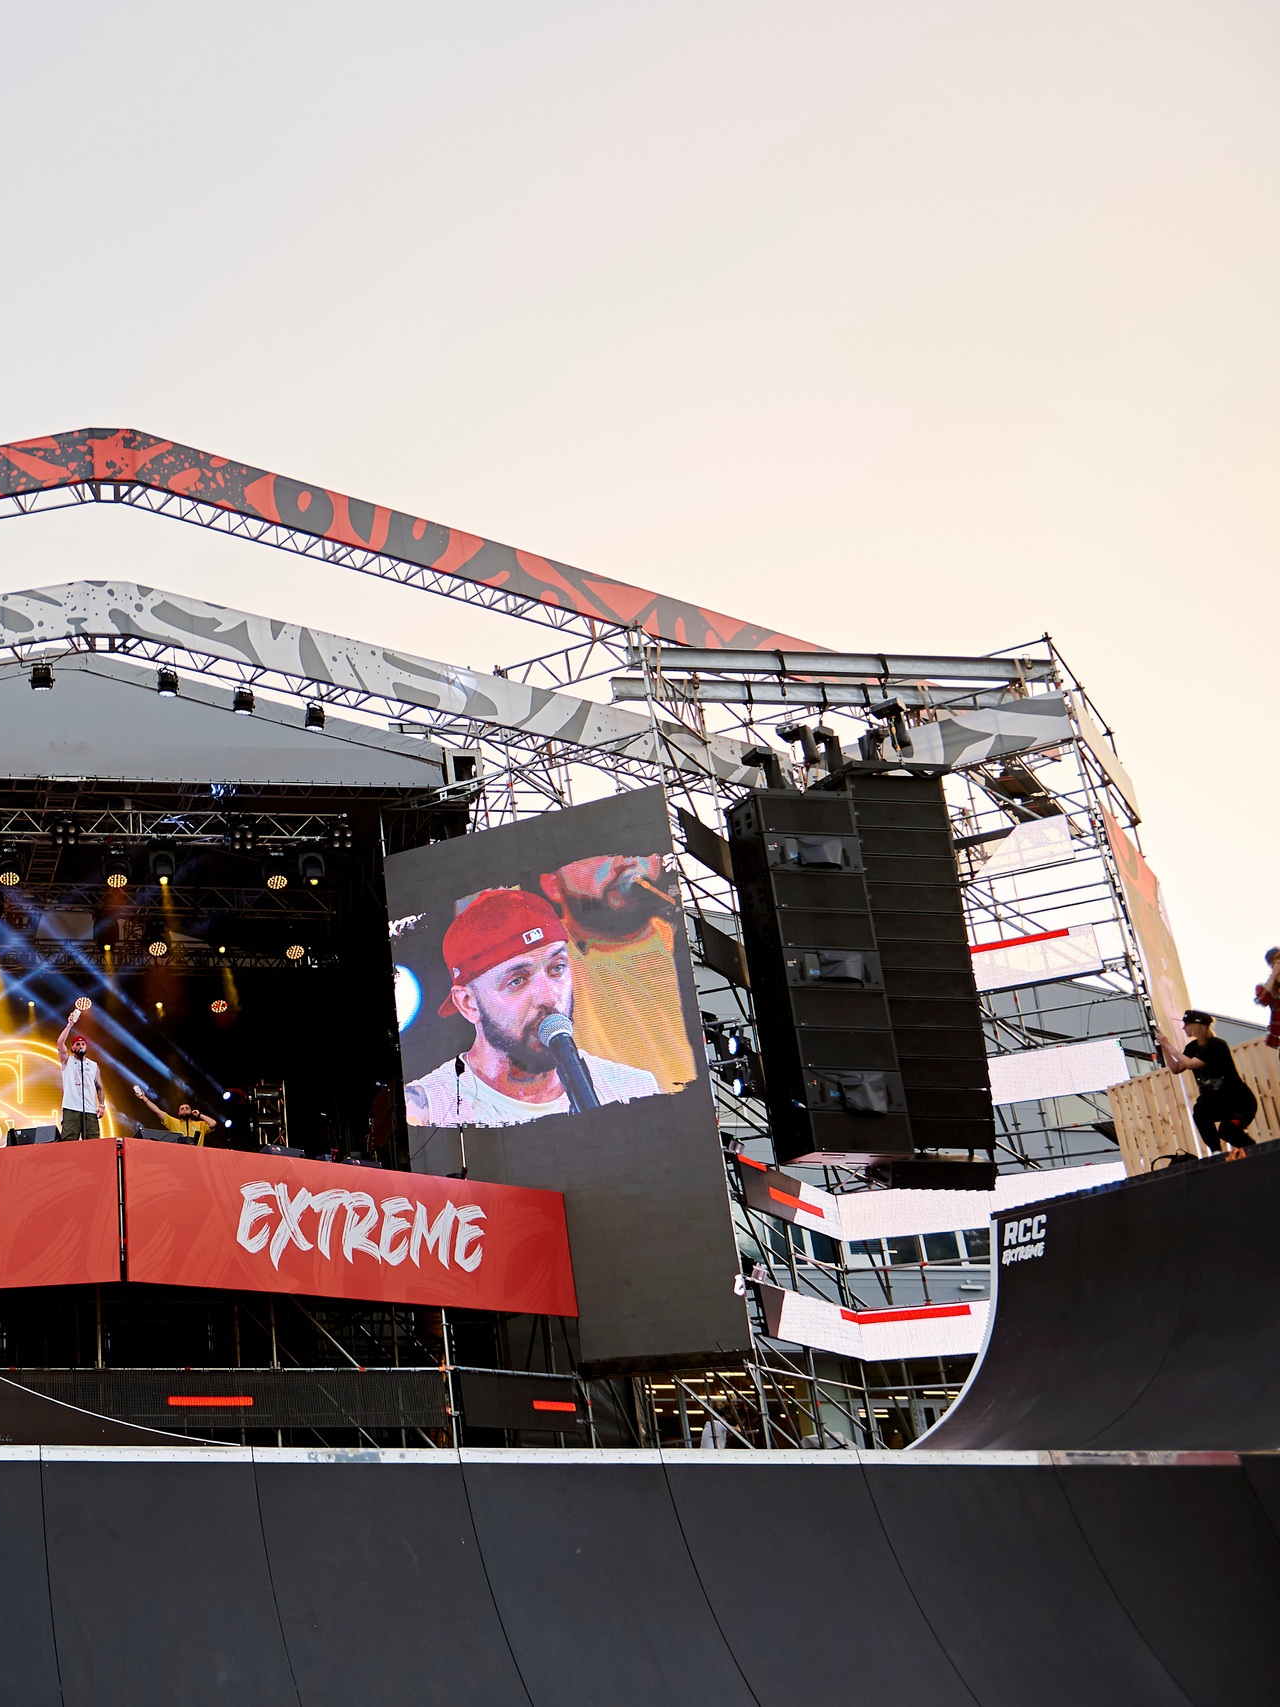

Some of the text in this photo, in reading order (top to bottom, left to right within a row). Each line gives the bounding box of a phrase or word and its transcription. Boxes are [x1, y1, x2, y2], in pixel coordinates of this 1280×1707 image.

[236, 1180, 487, 1272] EXTREME
[1004, 1214, 1047, 1246] RCC
[1002, 1242, 1045, 1266] EXTREME
